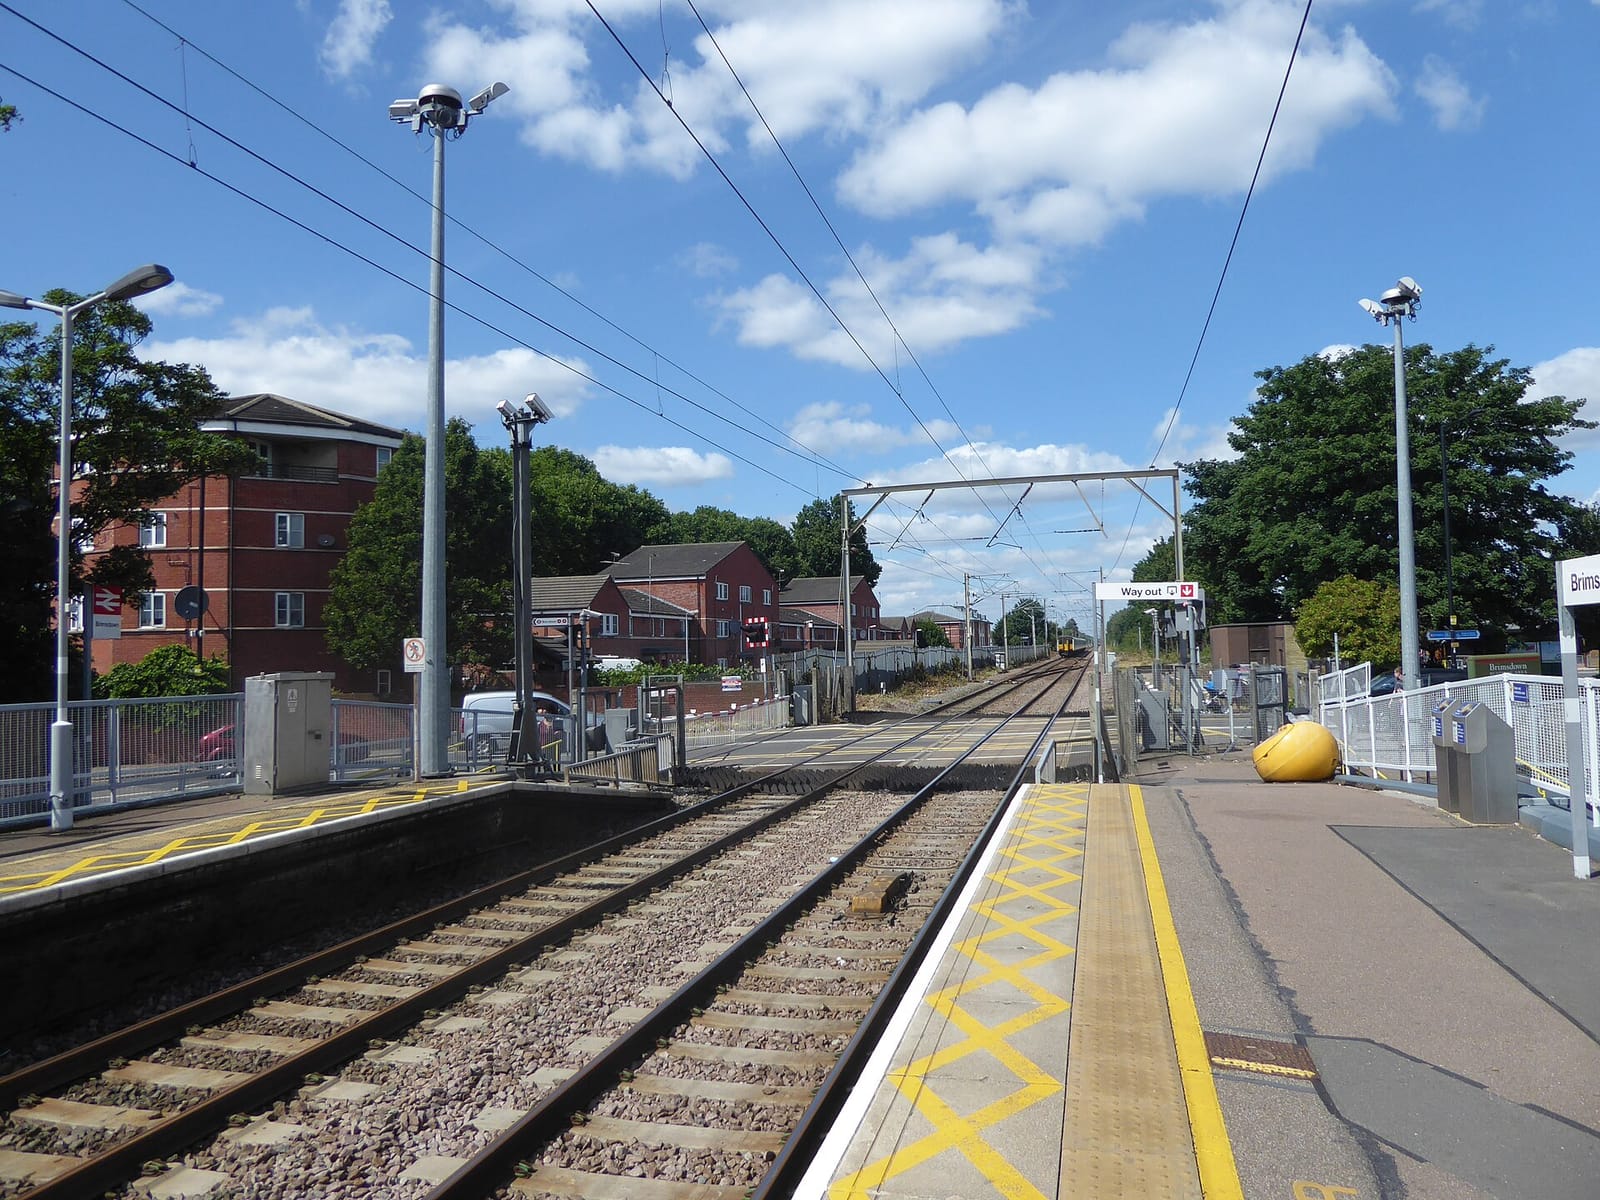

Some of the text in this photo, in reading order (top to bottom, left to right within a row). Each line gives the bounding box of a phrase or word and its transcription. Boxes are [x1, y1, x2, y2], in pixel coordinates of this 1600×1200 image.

[1570, 572, 1600, 592] Brims
[1121, 587, 1162, 598] Way out
[1489, 662, 1528, 671] Brimsdown
